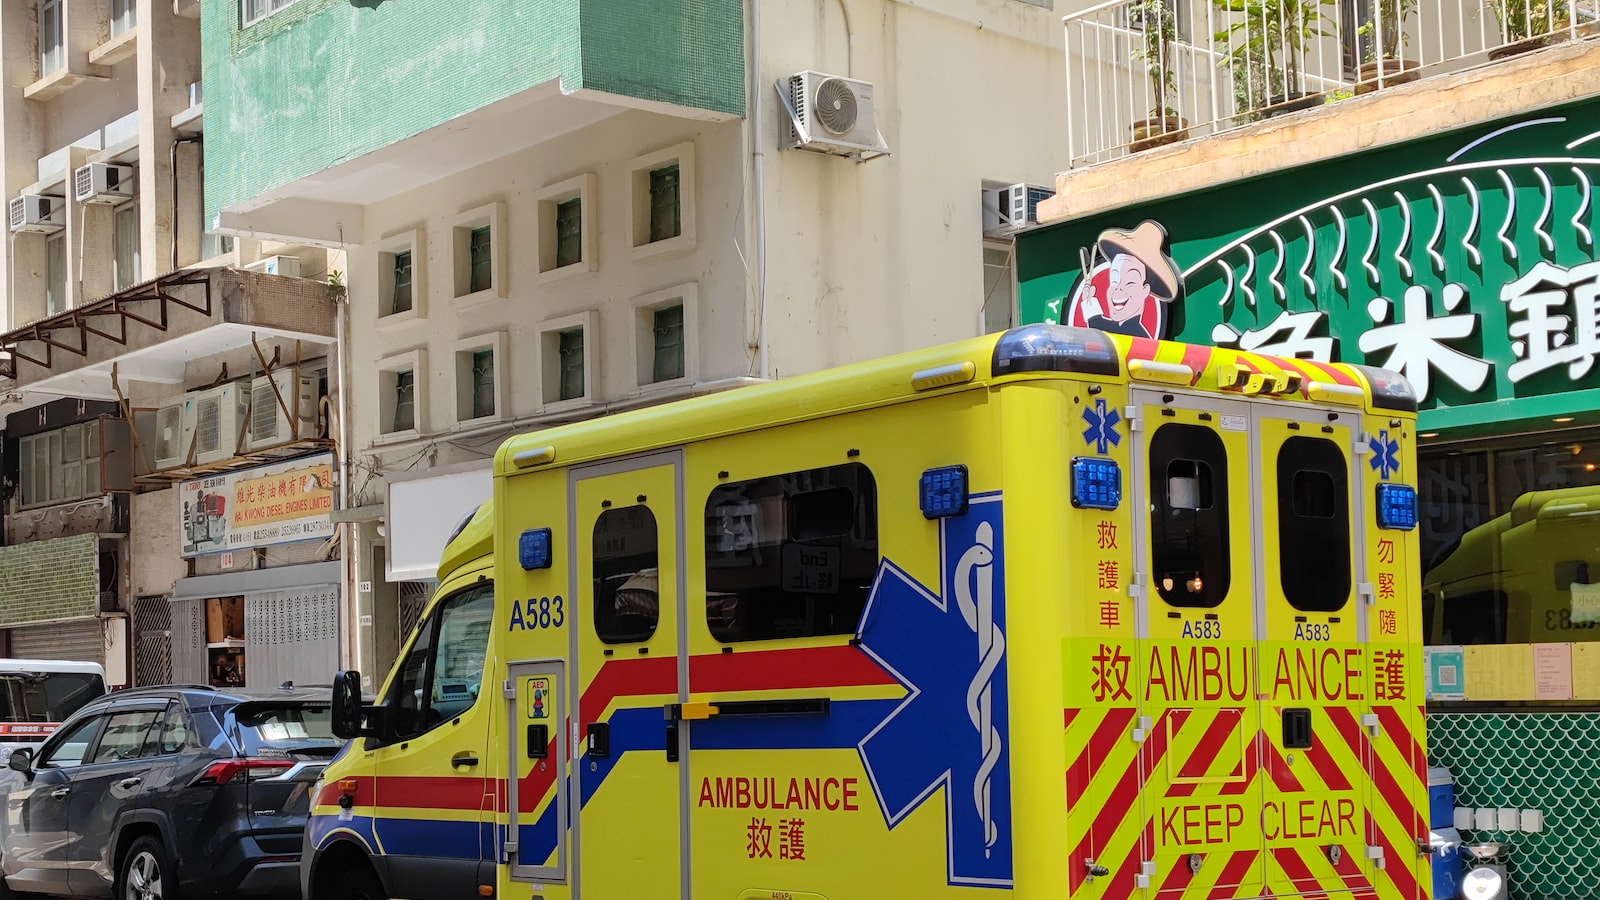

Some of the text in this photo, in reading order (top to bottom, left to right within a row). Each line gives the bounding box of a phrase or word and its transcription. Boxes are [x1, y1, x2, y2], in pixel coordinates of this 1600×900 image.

[236, 470, 329, 504] 維光柴油機有限司
[234, 495, 331, 522] WAI KWONG DIESEL ENGINES LIMITED
[1097, 520, 1120, 629] 救護車
[1377, 538, 1397, 635] 勿緊隨
[509, 595, 564, 632] A583
[1182, 620, 1221, 639] A583
[1294, 623, 1331, 641] A583
[532, 681, 545, 689] AED
[1091, 643, 1133, 702] 救
[1145, 645, 1364, 702] AMBULANCE
[1373, 649, 1407, 701] 護
[698, 777, 859, 811] AMBULANCE
[746, 817, 806, 861] 救護
[1161, 798, 1357, 847] KEEP CLEAR
